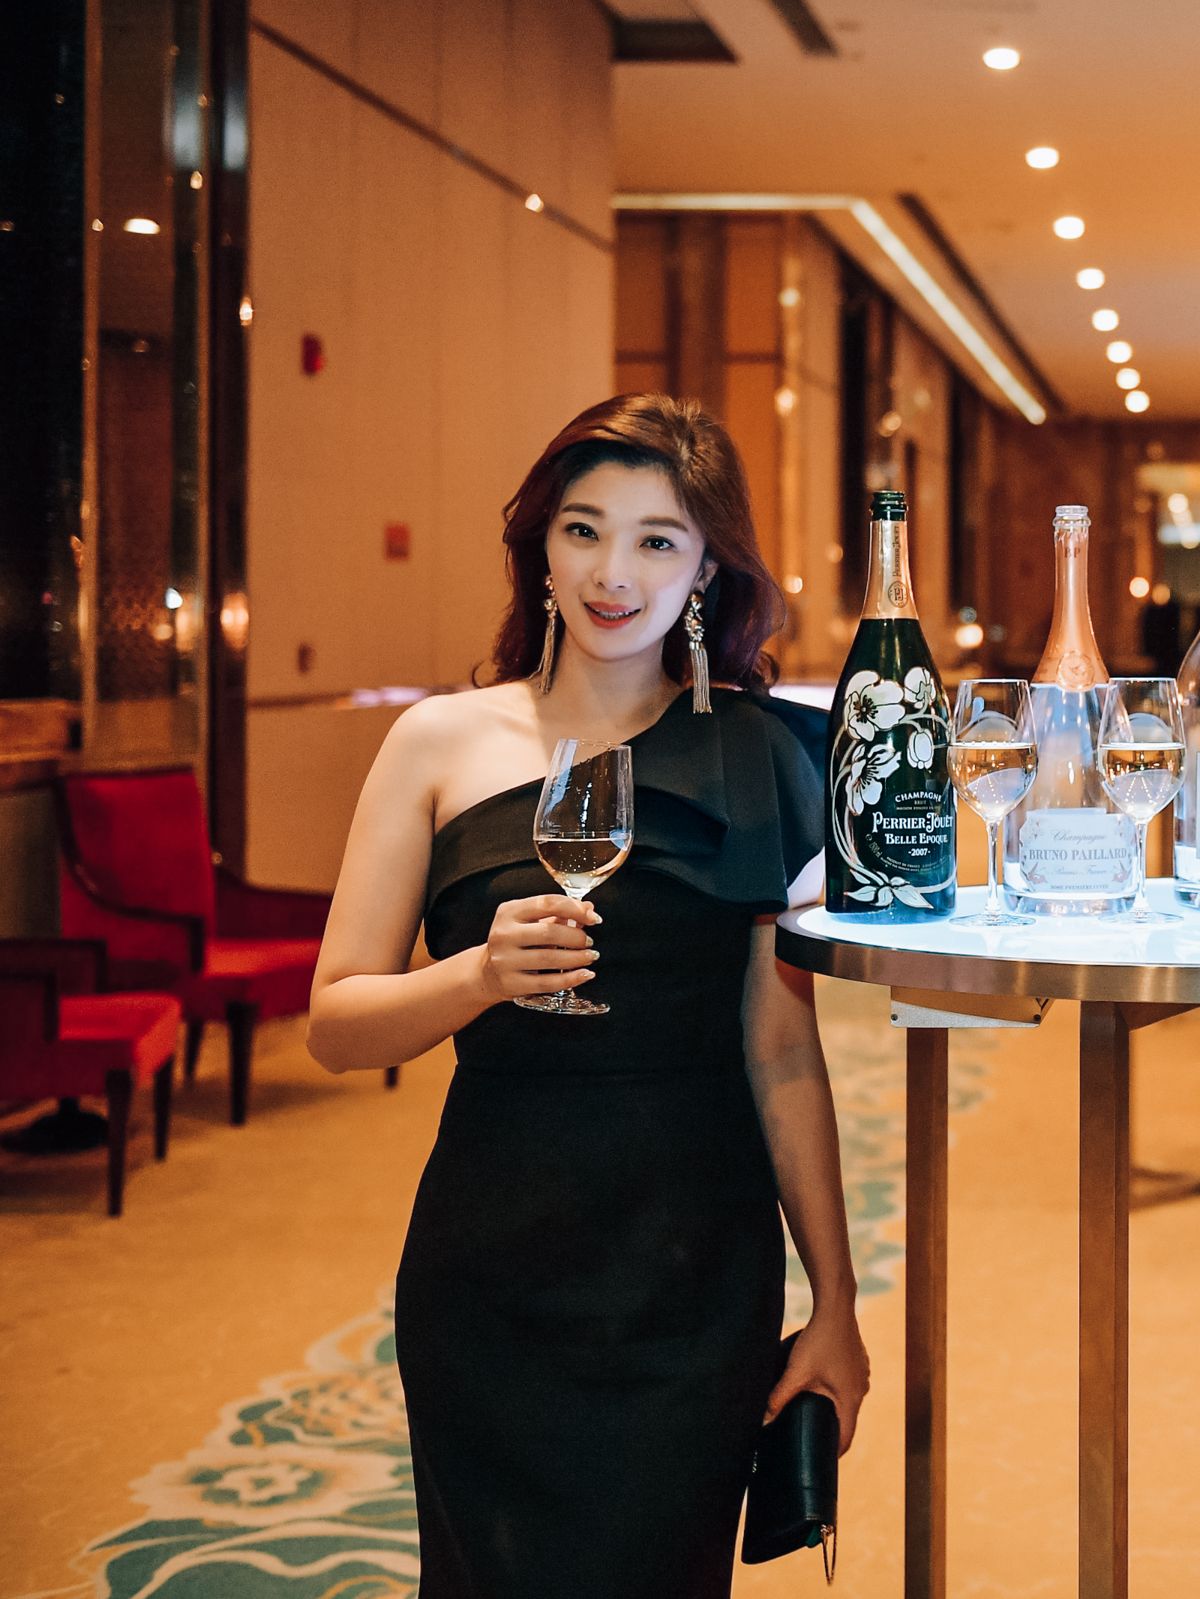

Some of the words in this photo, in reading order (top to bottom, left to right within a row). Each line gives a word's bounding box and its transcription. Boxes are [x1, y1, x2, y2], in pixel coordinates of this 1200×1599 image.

[895, 791, 942, 803] CHAMPAGNE
[885, 833, 917, 845] BELLE
[919, 832, 949, 846] EPOQUE
[1029, 849, 1068, 861] BRUNO
[1072, 848, 1127, 861] PAILLARD
